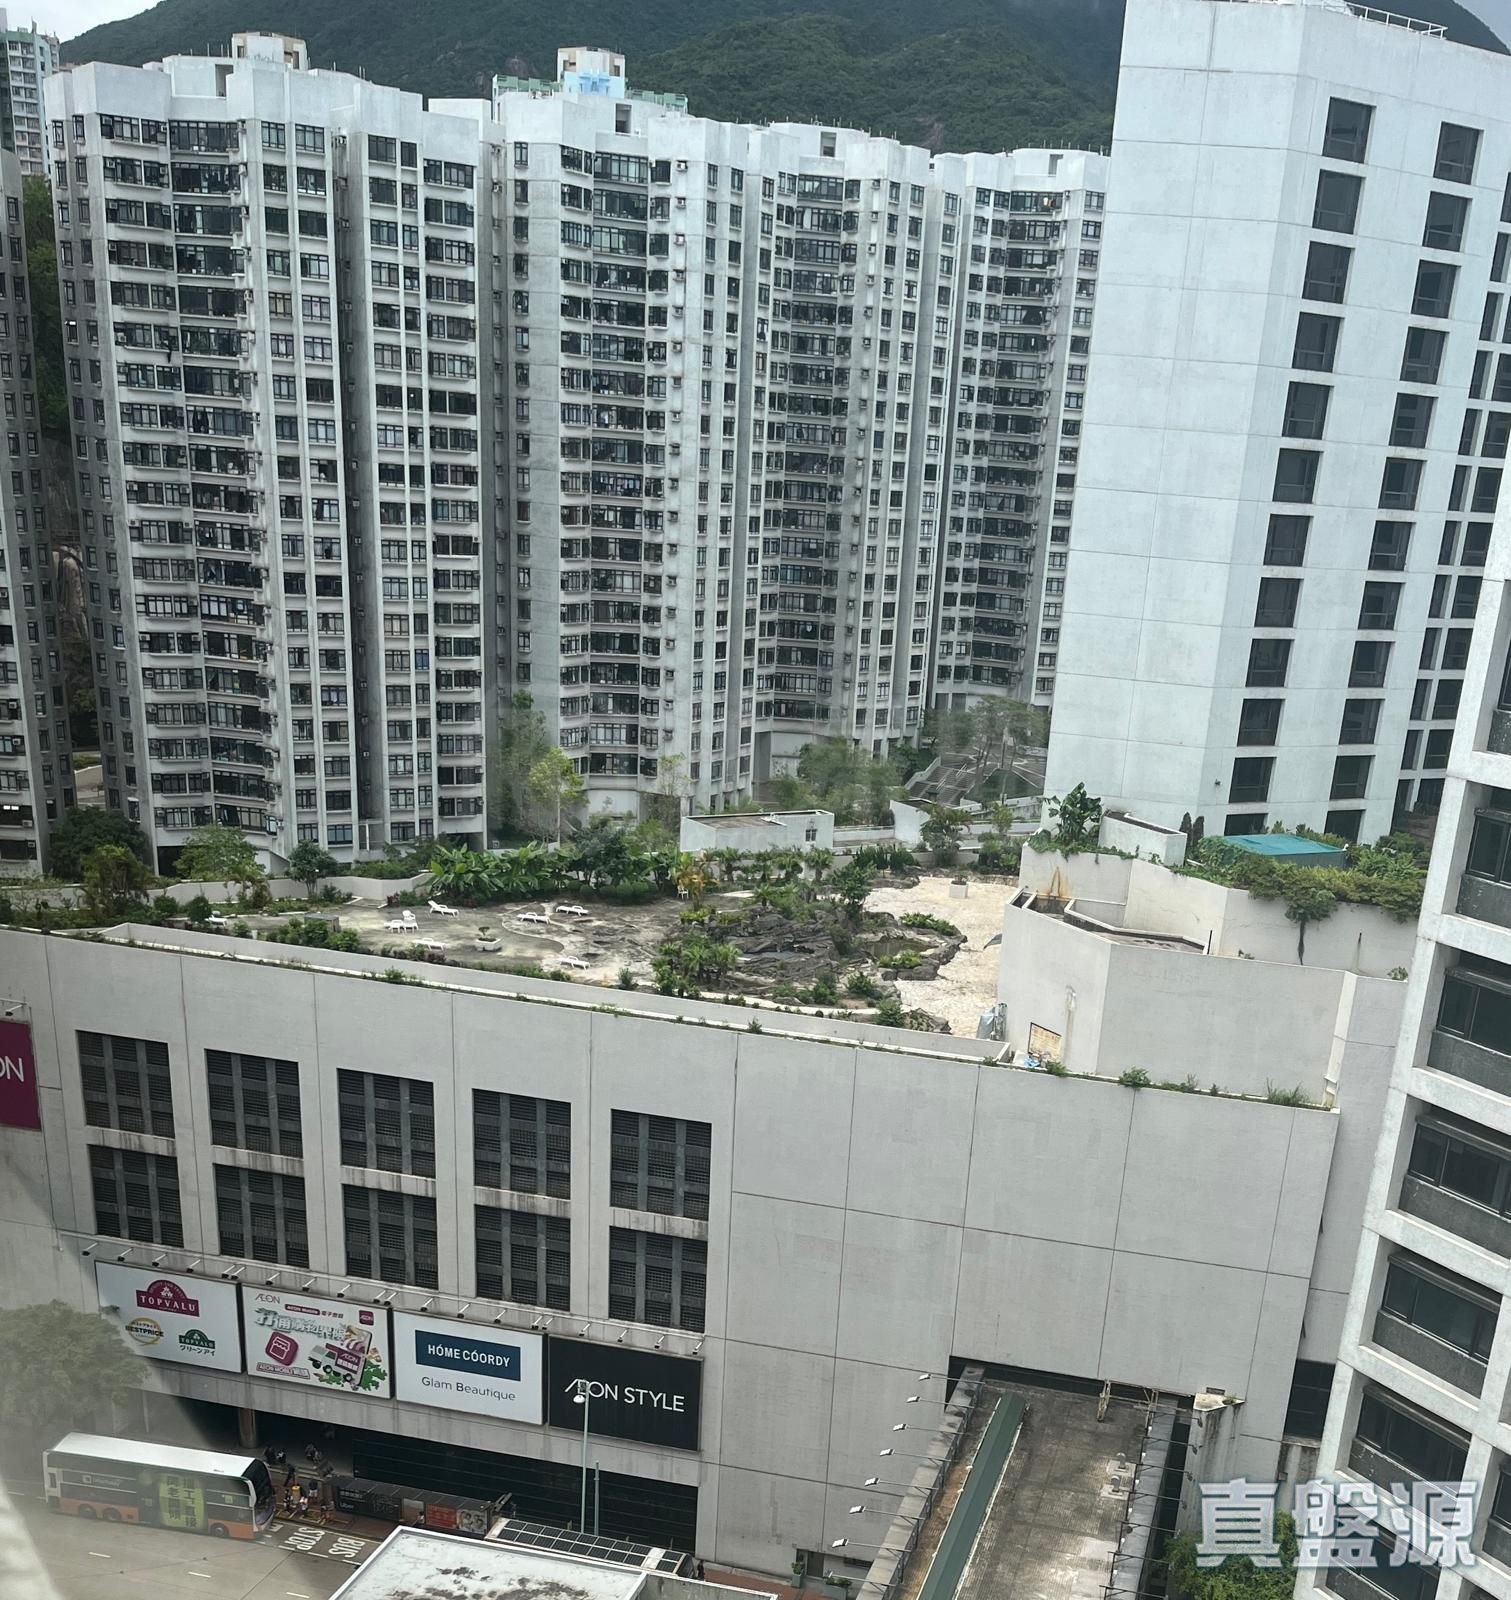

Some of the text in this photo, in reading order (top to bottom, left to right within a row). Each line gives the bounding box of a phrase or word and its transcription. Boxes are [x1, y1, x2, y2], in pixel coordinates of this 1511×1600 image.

[140, 1295, 196, 1312] TOPVALU
[421, 1376, 516, 1401] Glam Beautique
[623, 1387, 685, 1413] STYLE
[284, 1526, 326, 1551] STOP
[328, 1536, 366, 1558] BUS
